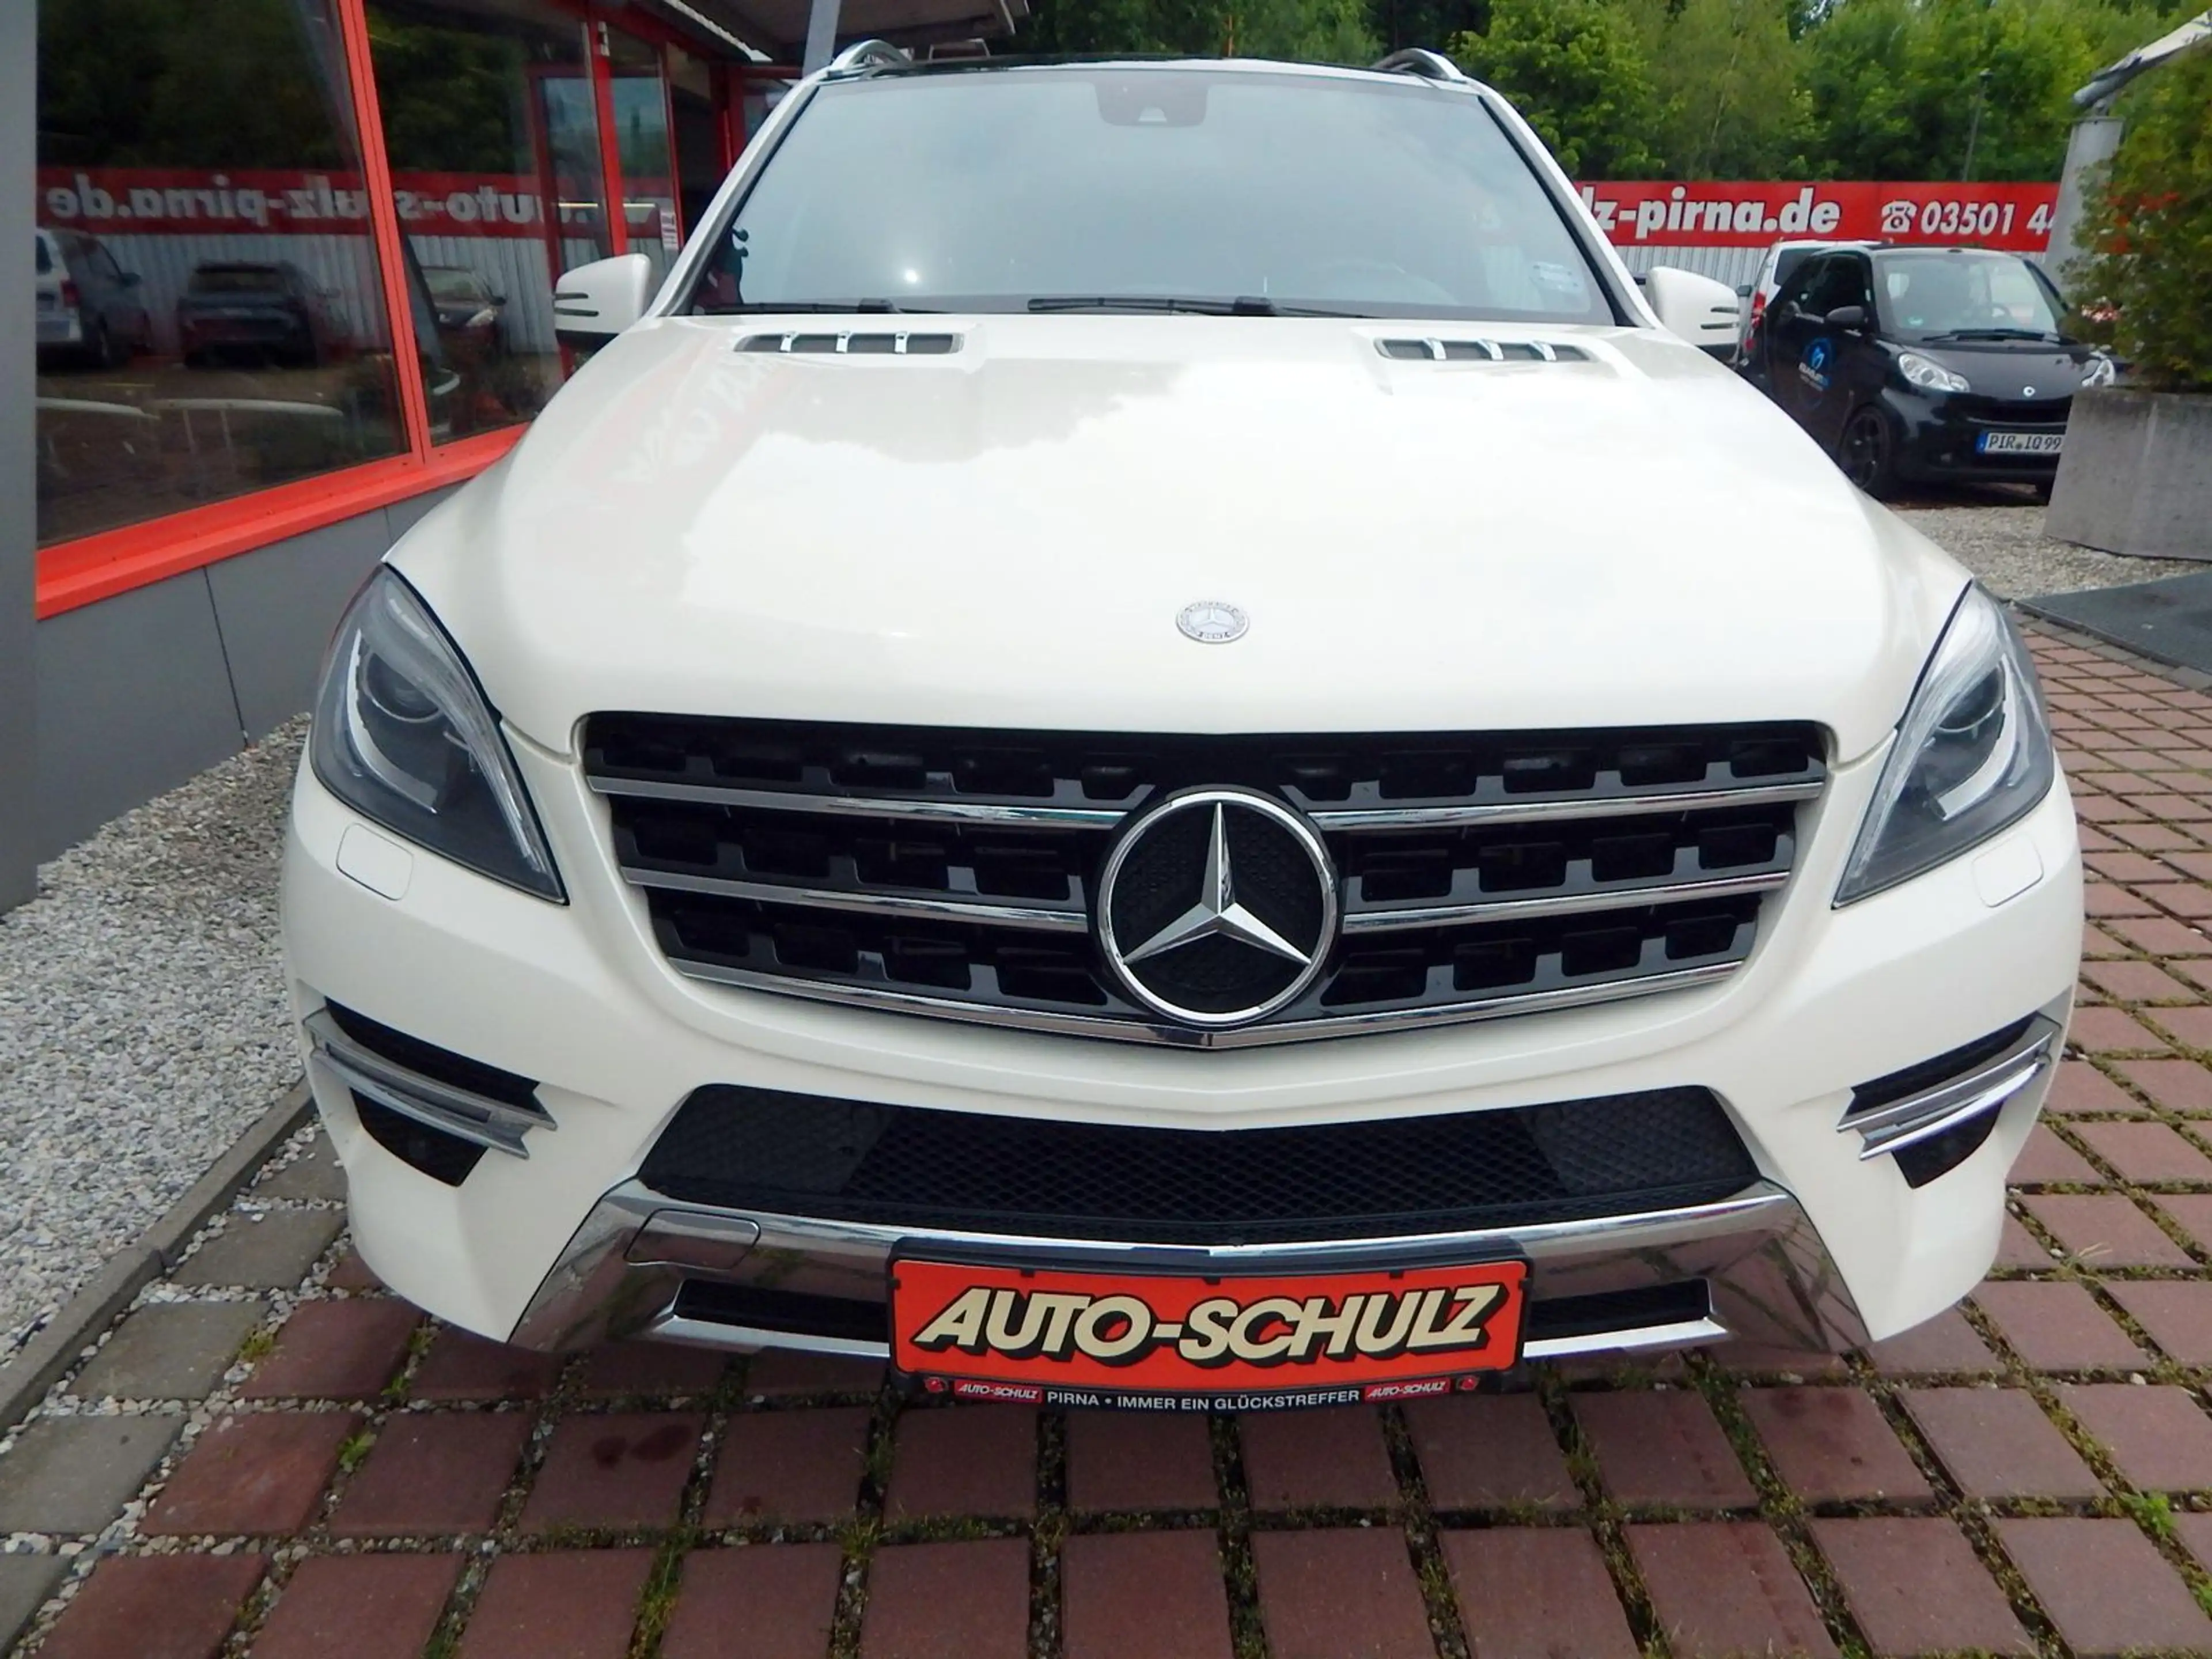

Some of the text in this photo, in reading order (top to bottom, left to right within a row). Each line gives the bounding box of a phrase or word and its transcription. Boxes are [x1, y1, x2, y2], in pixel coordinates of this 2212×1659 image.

[1921, 201, 2015, 235] 03501
[2026, 203, 2058, 236] 4
[1988, 434, 2016, 449] PIR
[911, 1284, 1503, 1363] AUTO-SCHULZ
[958, 1384, 1039, 1399] AUTO-SCHULZ
[1367, 1381, 1447, 1398] AUTO-SCHULZ
[1047, 1389, 1359, 1411] PIRNA IMMER EIN GLÜCKSTREFFER
